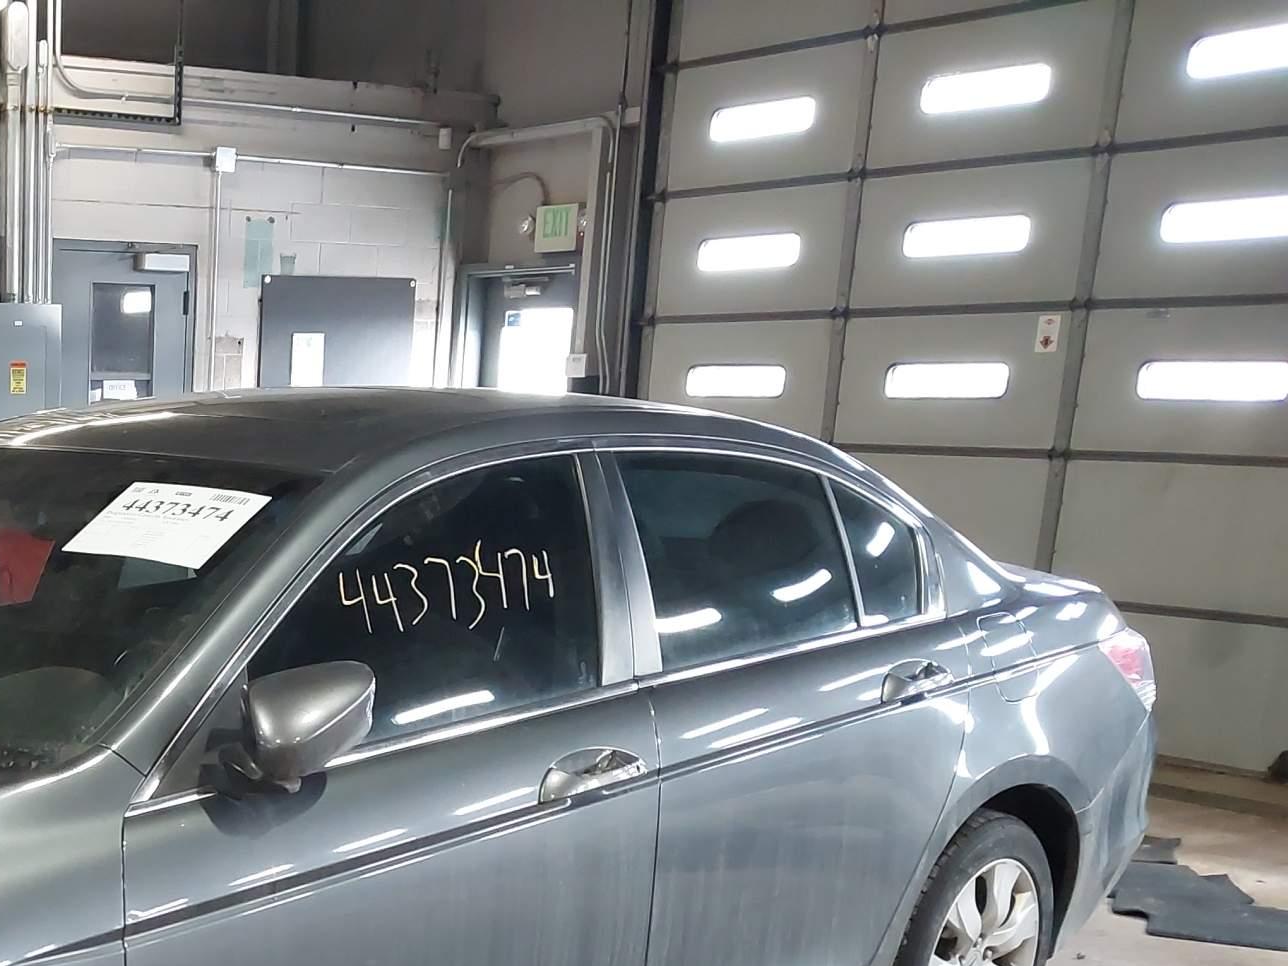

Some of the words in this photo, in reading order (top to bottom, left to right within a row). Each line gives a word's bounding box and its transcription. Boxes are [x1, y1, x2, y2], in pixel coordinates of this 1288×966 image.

[543, 208, 572, 238] EXIT
[122, 499, 233, 522] 44373474
[338, 539, 555, 634] 44373474
